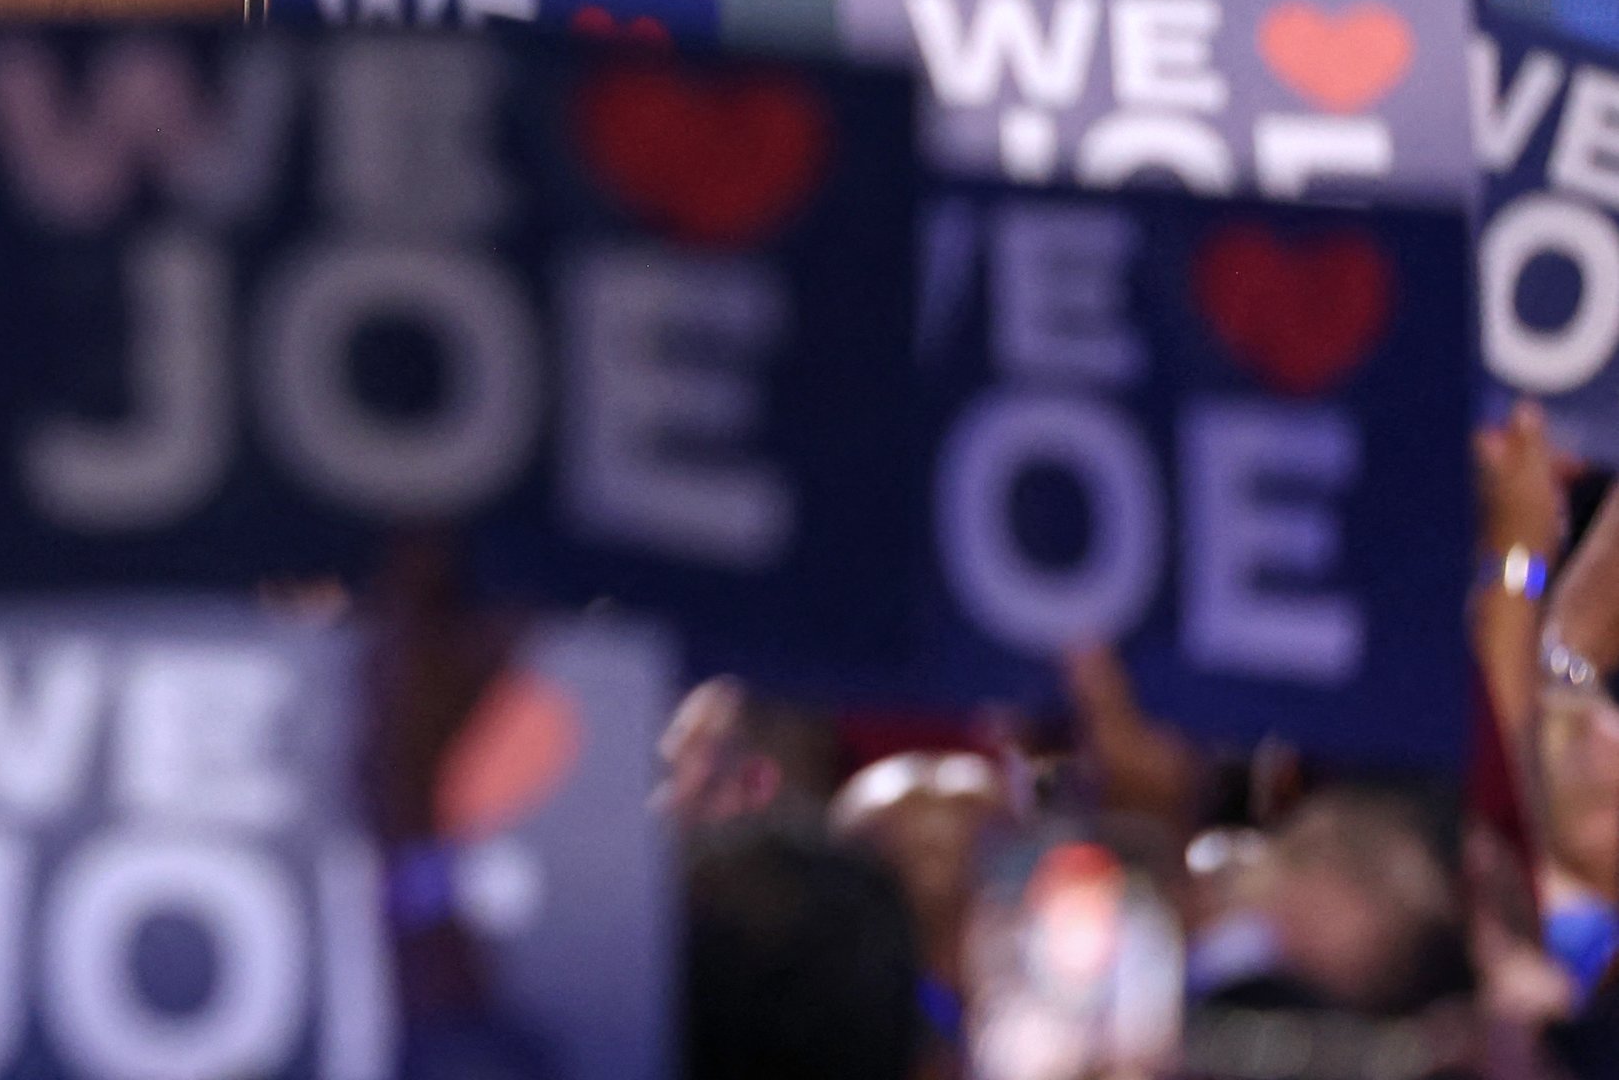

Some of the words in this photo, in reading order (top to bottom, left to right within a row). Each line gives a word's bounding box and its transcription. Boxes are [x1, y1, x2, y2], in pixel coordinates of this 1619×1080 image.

[14, 228, 798, 568] JOE
[910, 200, 1148, 388] E
[930, 396, 1366, 680] OE
